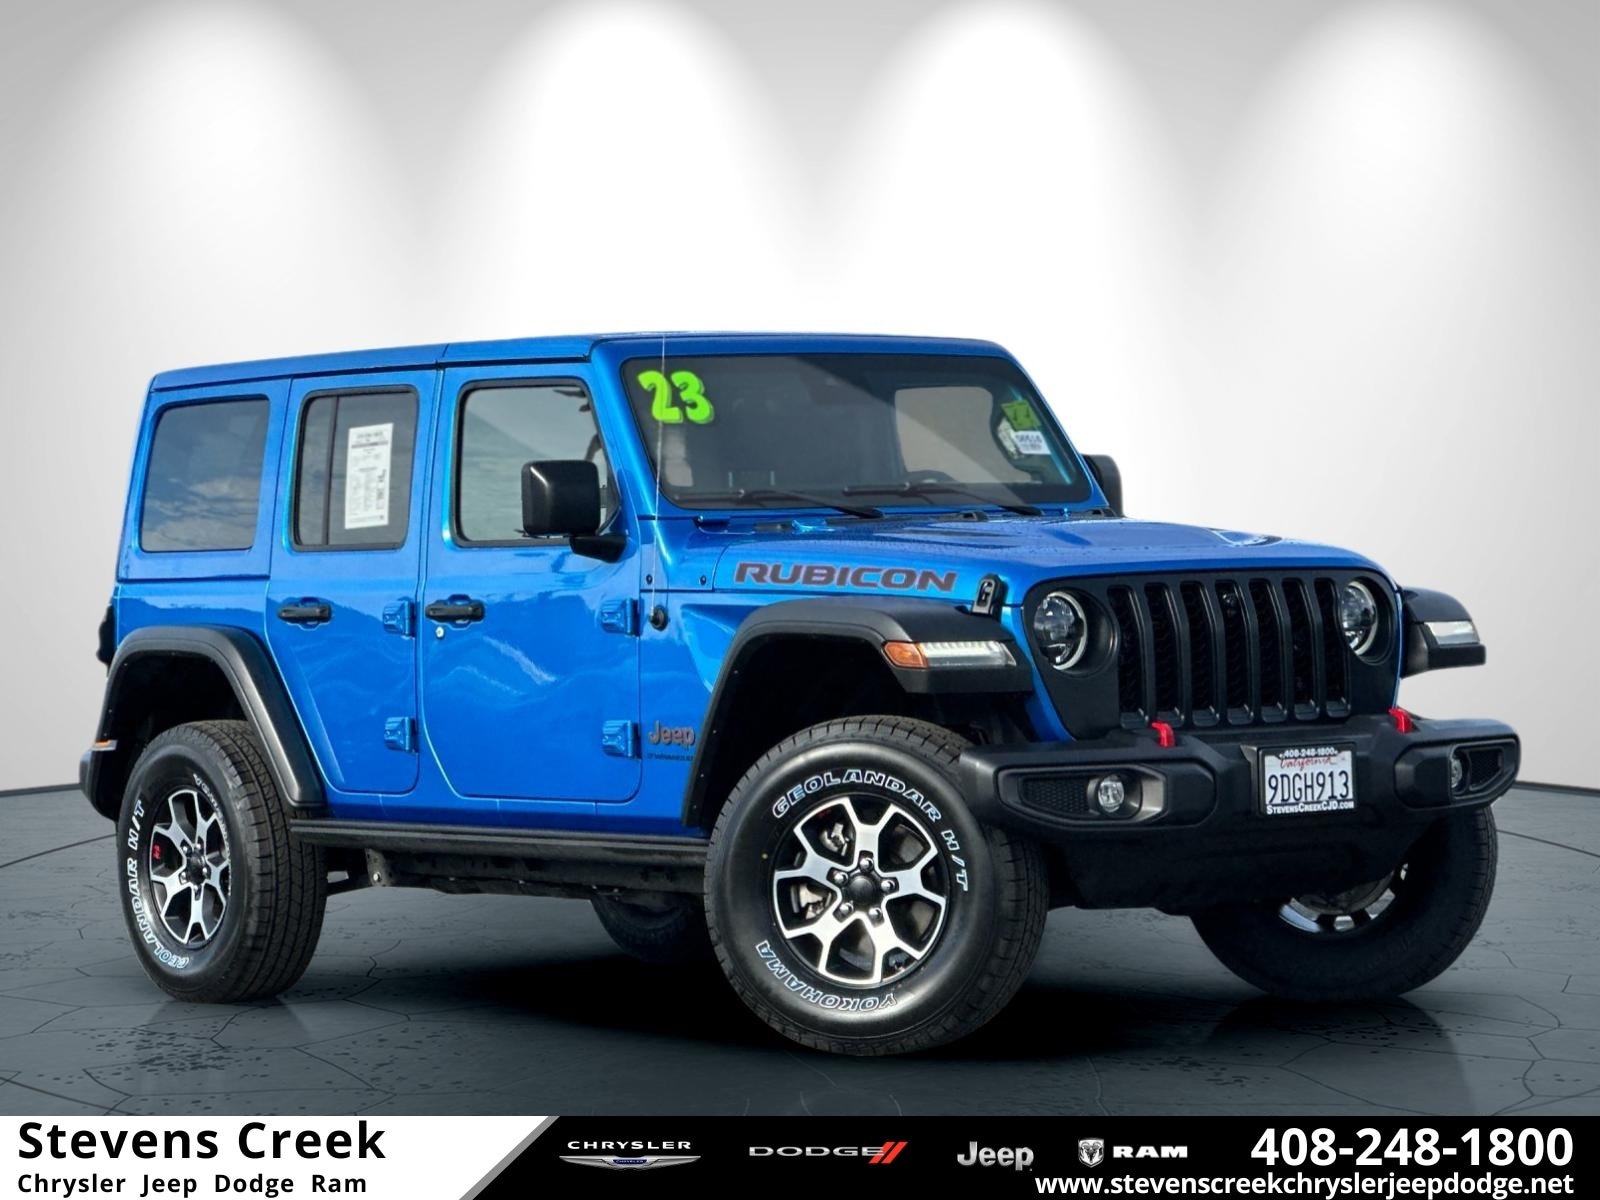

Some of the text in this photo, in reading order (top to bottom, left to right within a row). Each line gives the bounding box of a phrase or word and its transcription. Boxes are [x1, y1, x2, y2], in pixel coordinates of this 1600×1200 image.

[637, 370, 715, 425] 23
[734, 561, 958, 593] RUBICON
[648, 720, 696, 751] Jeep
[1268, 770, 1350, 805] 9DGH913
[772, 769, 969, 892] GEOLANDAR H/T
[126, 799, 190, 969] GEOLANDAR H/T
[755, 939, 898, 1012] YOKOHAMA
